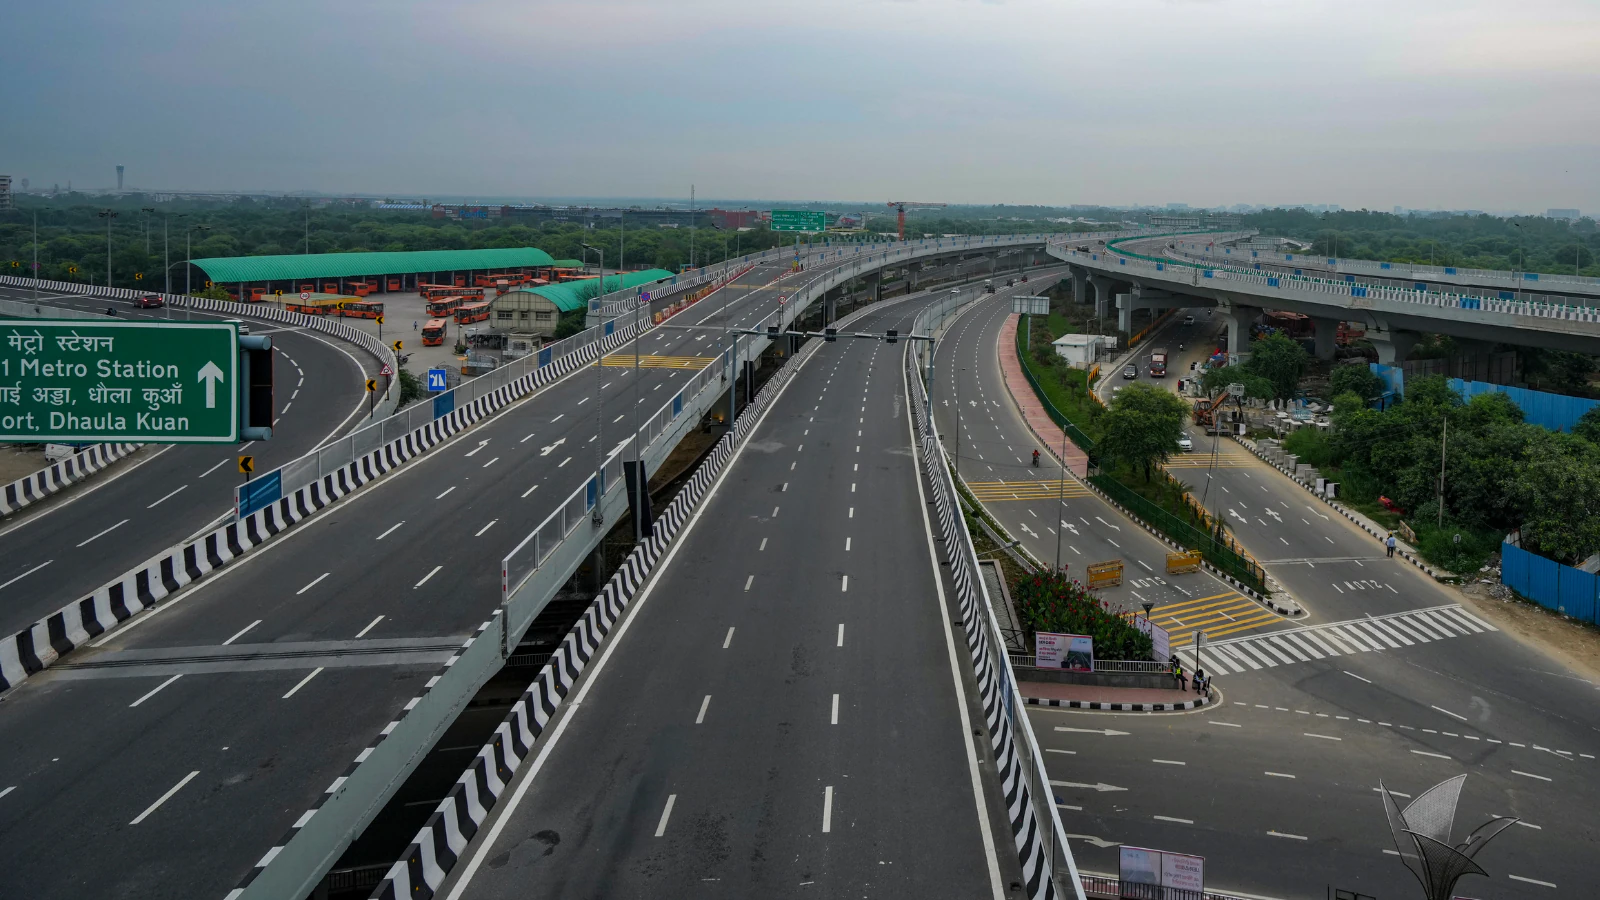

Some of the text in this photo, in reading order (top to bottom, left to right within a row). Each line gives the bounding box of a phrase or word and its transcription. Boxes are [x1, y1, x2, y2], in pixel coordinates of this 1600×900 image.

[7, 329, 115, 355] मेट्रो स्टेशन
[1, 358, 179, 379] 1 Metro Station
[0, 380, 21, 406] ाई
[88, 382, 132, 404] धौला
[142, 382, 183, 411] कुआँ
[50, 411, 127, 430] Dhaula
[137, 412, 189, 431] Kuan
